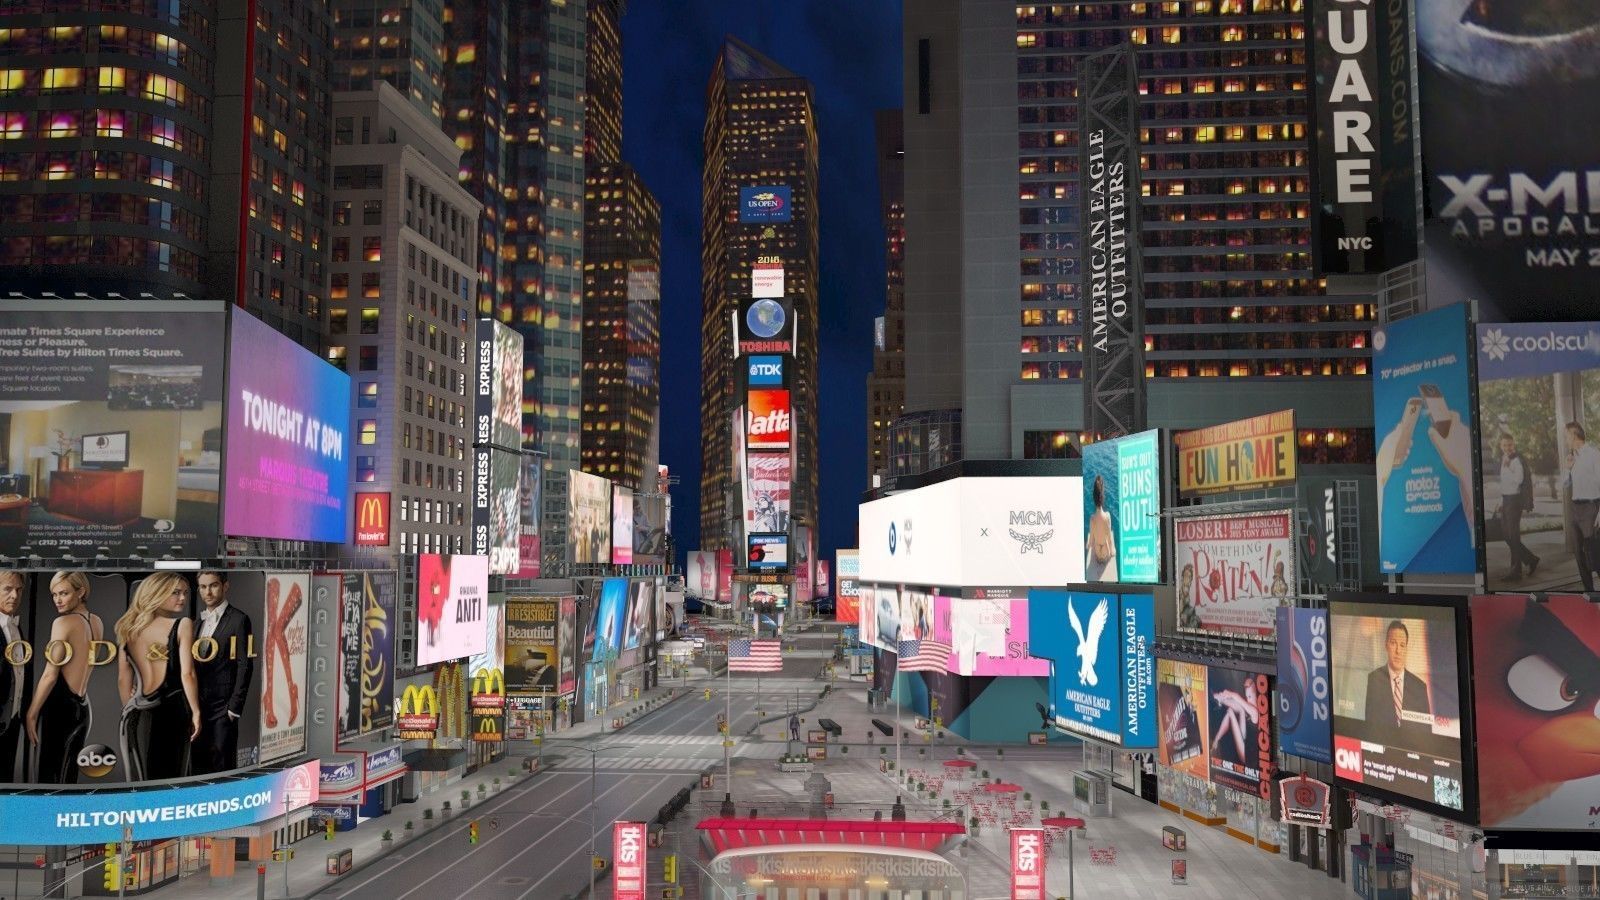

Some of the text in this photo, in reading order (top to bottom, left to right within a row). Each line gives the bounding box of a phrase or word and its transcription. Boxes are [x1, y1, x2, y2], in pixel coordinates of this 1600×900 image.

[1327, 0, 1375, 204] UARE
[1089, 129, 1108, 353] AMERICAN EAGLE
[1109, 161, 1127, 318] OUTFITTERS
[1338, 237, 1373, 250] NYC
[757, 256, 780, 264] 2016
[1526, 249, 1581, 267] MAY
[30, 327, 62, 336] Times
[64, 327, 102, 338] Square
[105, 327, 165, 338] Experience
[39, 337, 87, 346] Pleasure.
[22, 348, 54, 357] Suites
[58, 348, 69, 359] by
[73, 348, 105, 357] Hilton
[108, 348, 140, 357] Times
[143, 348, 184, 359] Square.
[739, 341, 791, 352] TOSHIBA
[480, 340, 490, 395] EXPRESS
[757, 364, 781, 375] TDK
[242, 389, 342, 461] TONIGHT AT 8PM
[1139, 452, 1152, 466] OUT
[1186, 435, 1286, 486] FUN HOME
[478, 452, 489, 508] EXPRESS
[1121, 468, 1152, 499] BUNS
[1009, 510, 1053, 525] MCM
[1122, 497, 1153, 532] OUT!
[1324, 487, 1336, 564] NEW
[1179, 521, 1228, 539] LOSER!
[1243, 529, 1260, 538] TONY
[1260, 528, 1284, 537] AWARD
[1199, 542, 1261, 557] SOMETHING
[456, 598, 481, 623] ANTI
[507, 607, 555, 622] IRRESISTIBLE!
[508, 625, 554, 639] Beautiful
[4, 635, 257, 667] OOD & OIL
[314, 587, 328, 724] PALACE
[1126, 608, 1138, 737] AMERICAN EAGLE
[1137, 635, 1146, 709] OUTFITTERS
[1310, 616, 1328, 721] SOLO 2
[1066, 689, 1110, 711] AMERICAN EAGLE
[1074, 702, 1100, 719] OUTFITTERS
[1256, 674, 1271, 801] CHICAGO
[77, 752, 117, 767] abc
[1222, 760, 1233, 770] ONE
[1244, 766, 1259, 777] ONLY
[1336, 748, 1360, 773] CNN
[56, 790, 272, 828] HILTONWEEKENDS.COM
[621, 827, 640, 863] tkts
[1018, 834, 1040, 871] tkts
